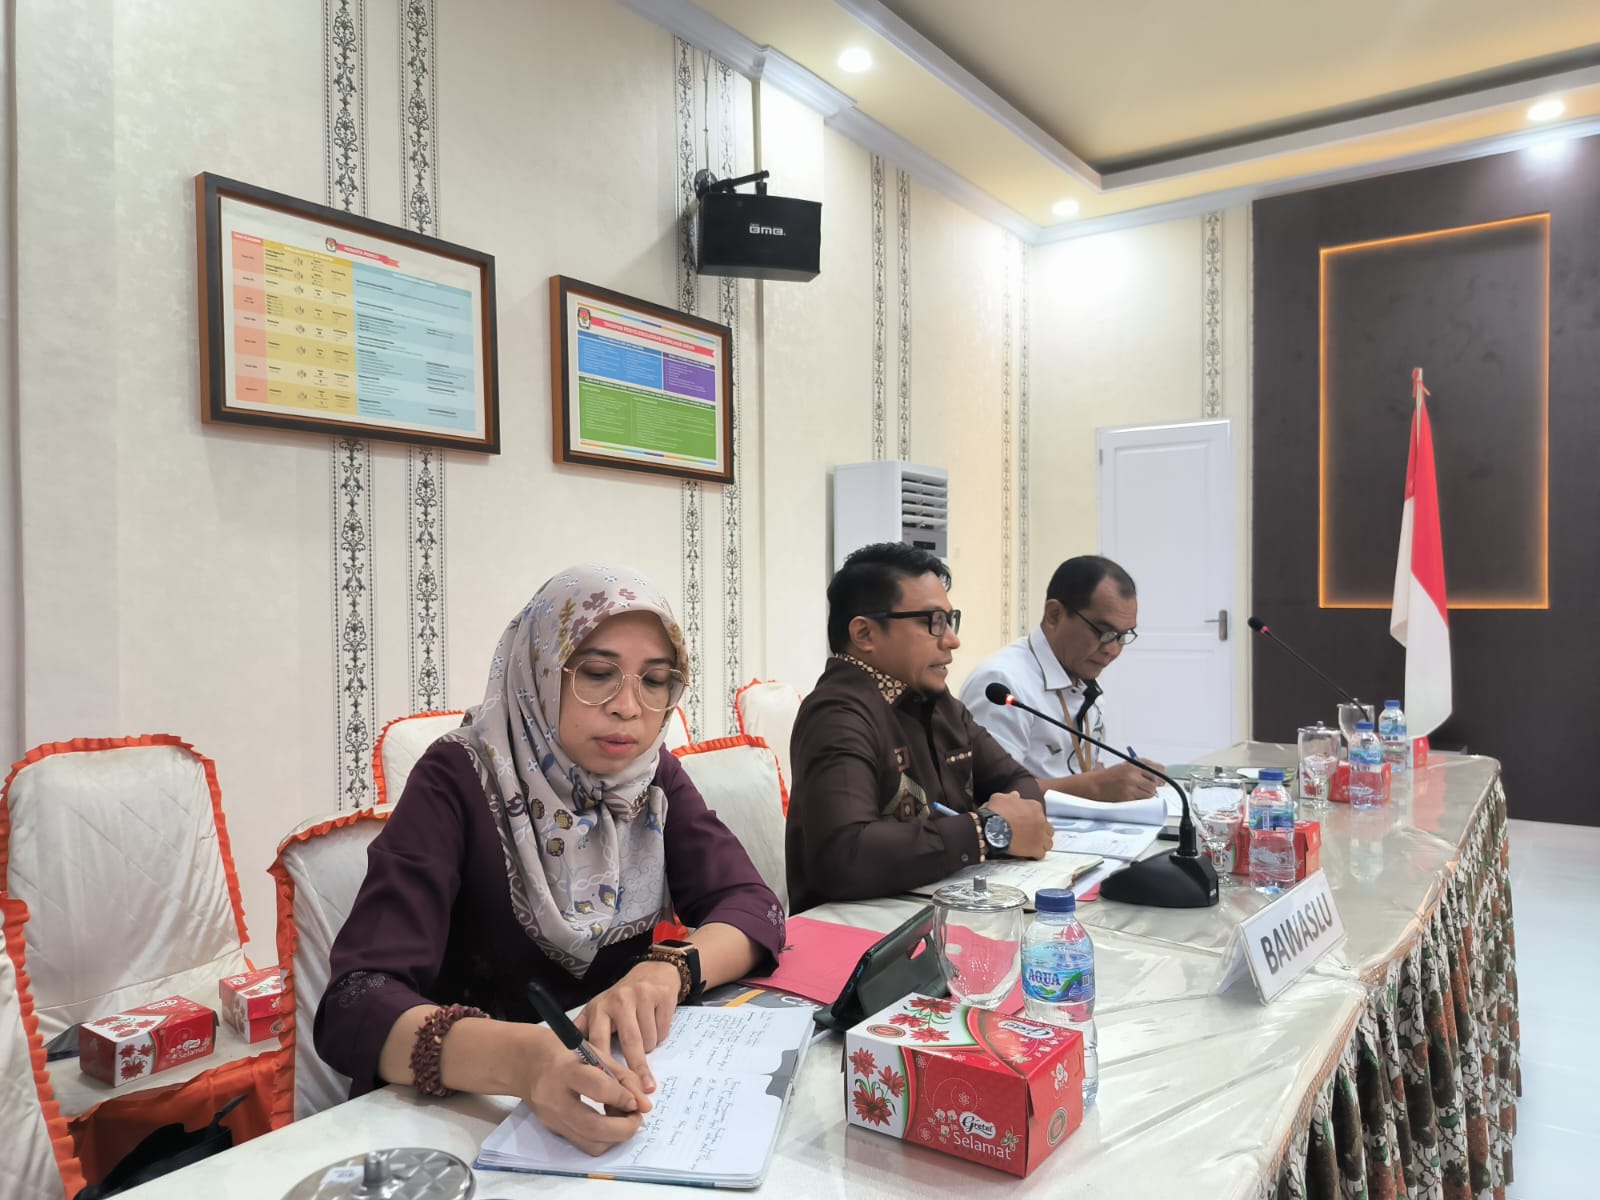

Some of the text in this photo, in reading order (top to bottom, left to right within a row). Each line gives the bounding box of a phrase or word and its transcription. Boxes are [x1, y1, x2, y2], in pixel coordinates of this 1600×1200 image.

[1260, 892, 1333, 976] BAWASLU
[1028, 968, 1062, 987] AQUA
[961, 1115, 994, 1135] Gretel
[953, 1131, 1012, 1160] Selamat
